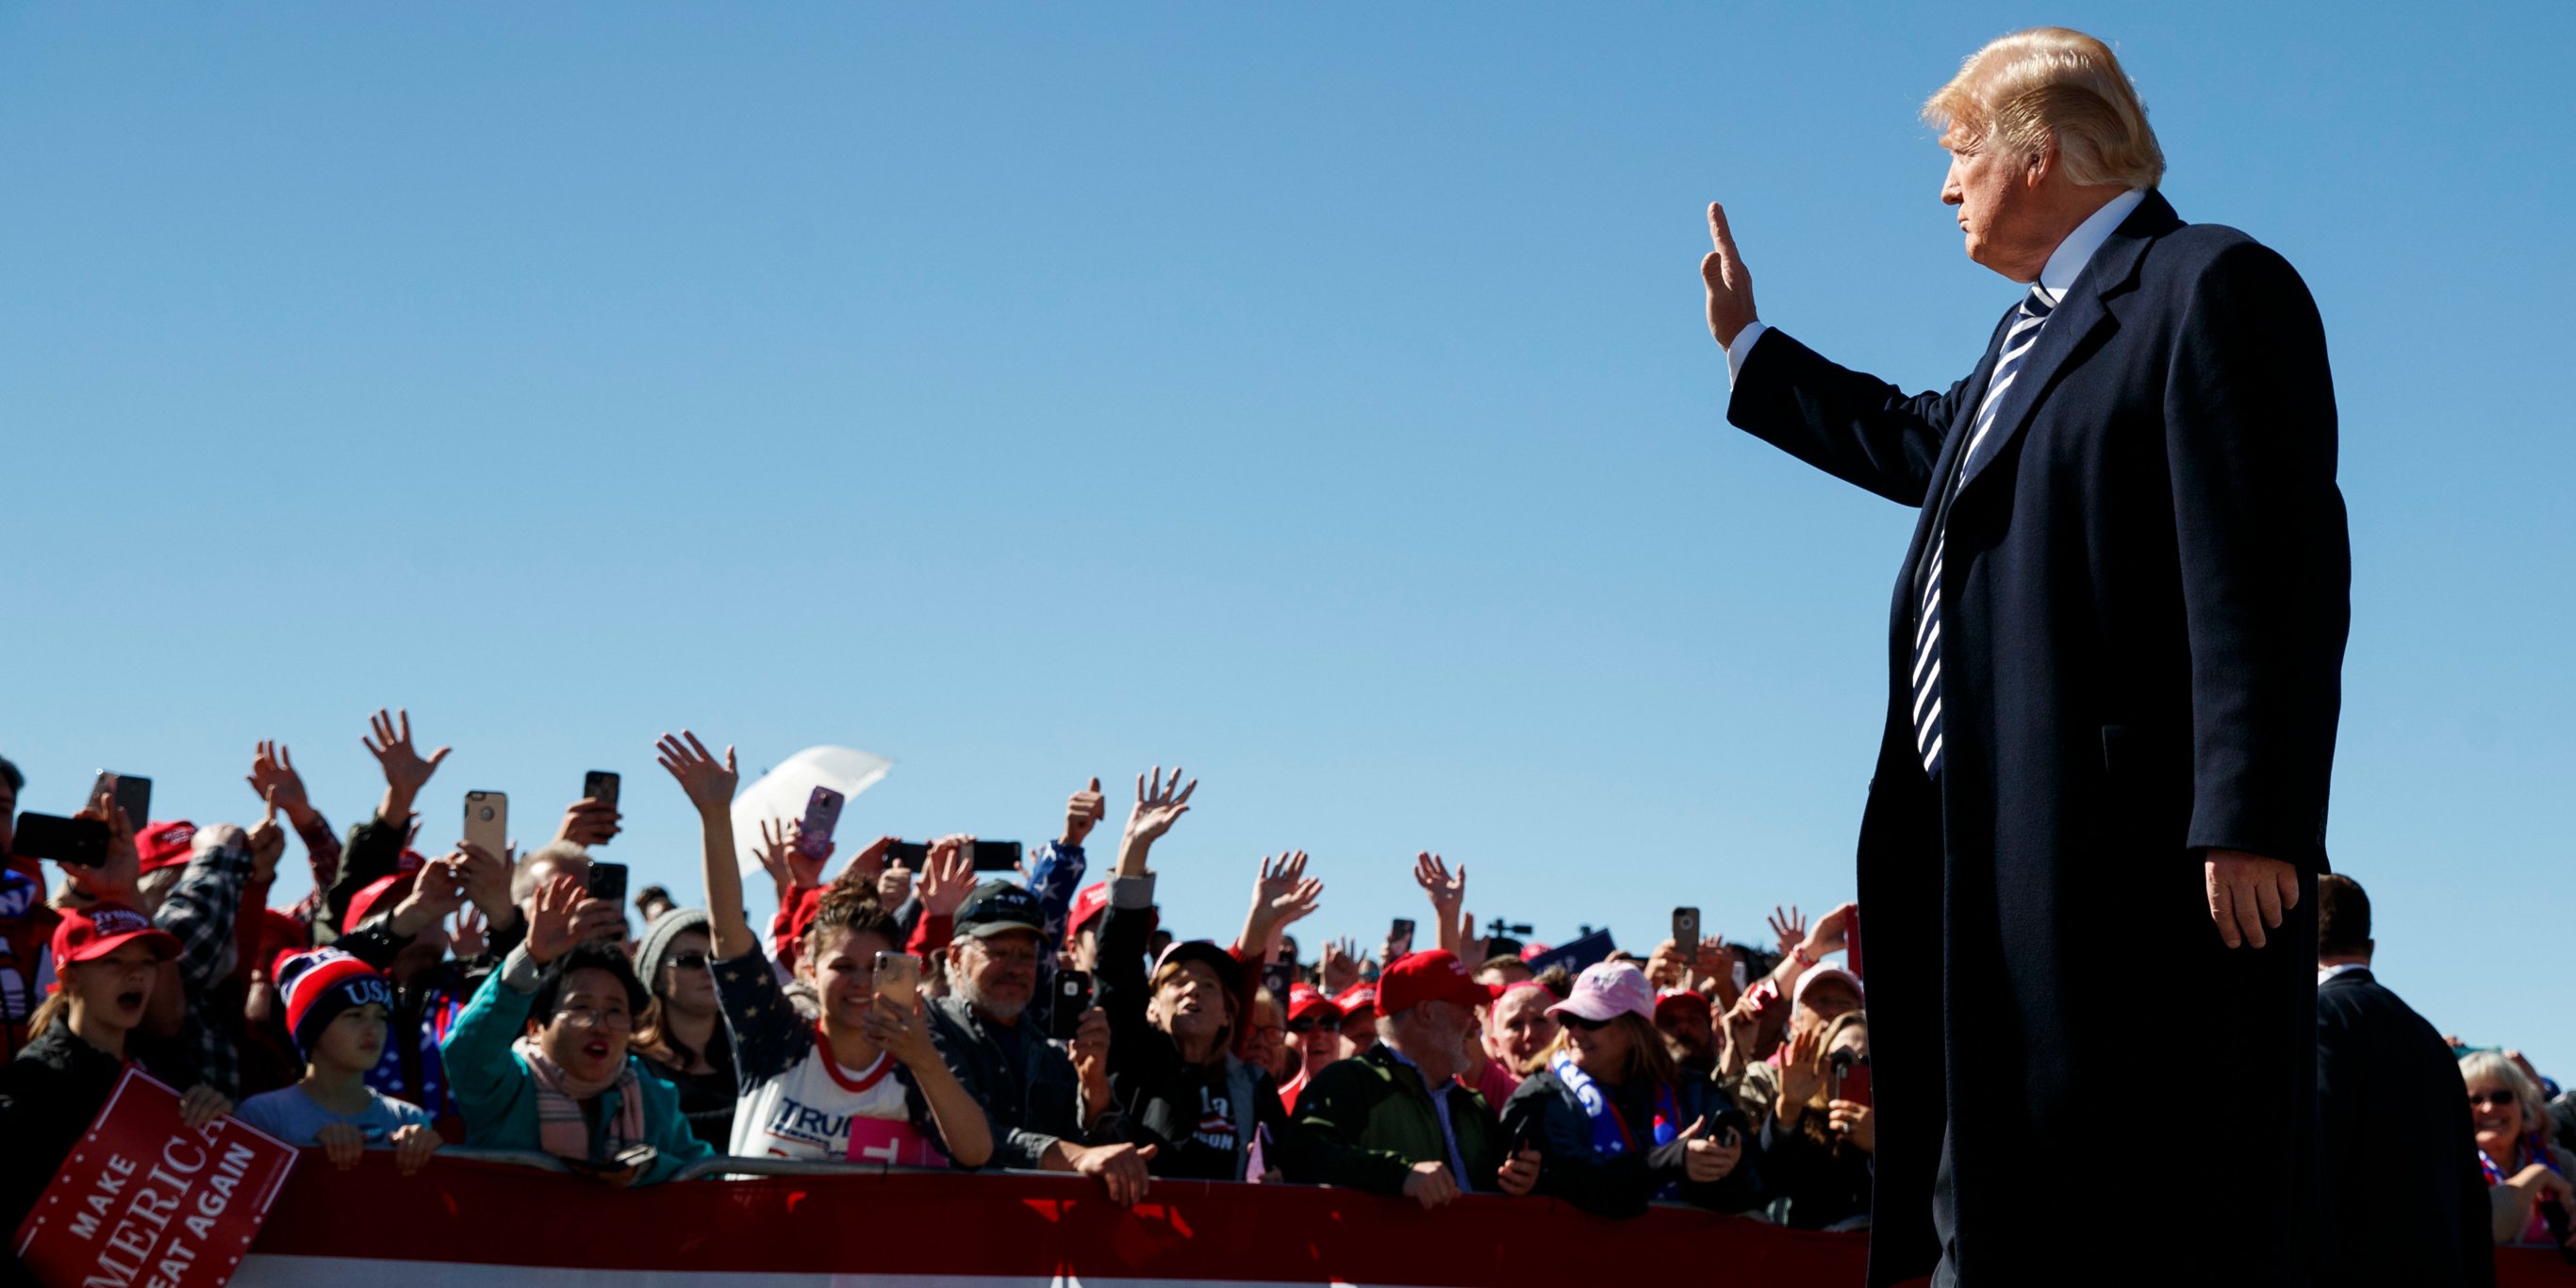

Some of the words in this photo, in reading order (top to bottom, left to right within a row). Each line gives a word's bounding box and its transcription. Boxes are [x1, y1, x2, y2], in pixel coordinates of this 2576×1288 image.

[343, 980, 394, 1012] USA
[777, 1097, 852, 1138] TRU
[68, 1152, 138, 1241] MAKE
[82, 1118, 227, 1288] MERICA
[144, 1237, 197, 1288] EAT
[183, 1141, 256, 1241] AGAIN
